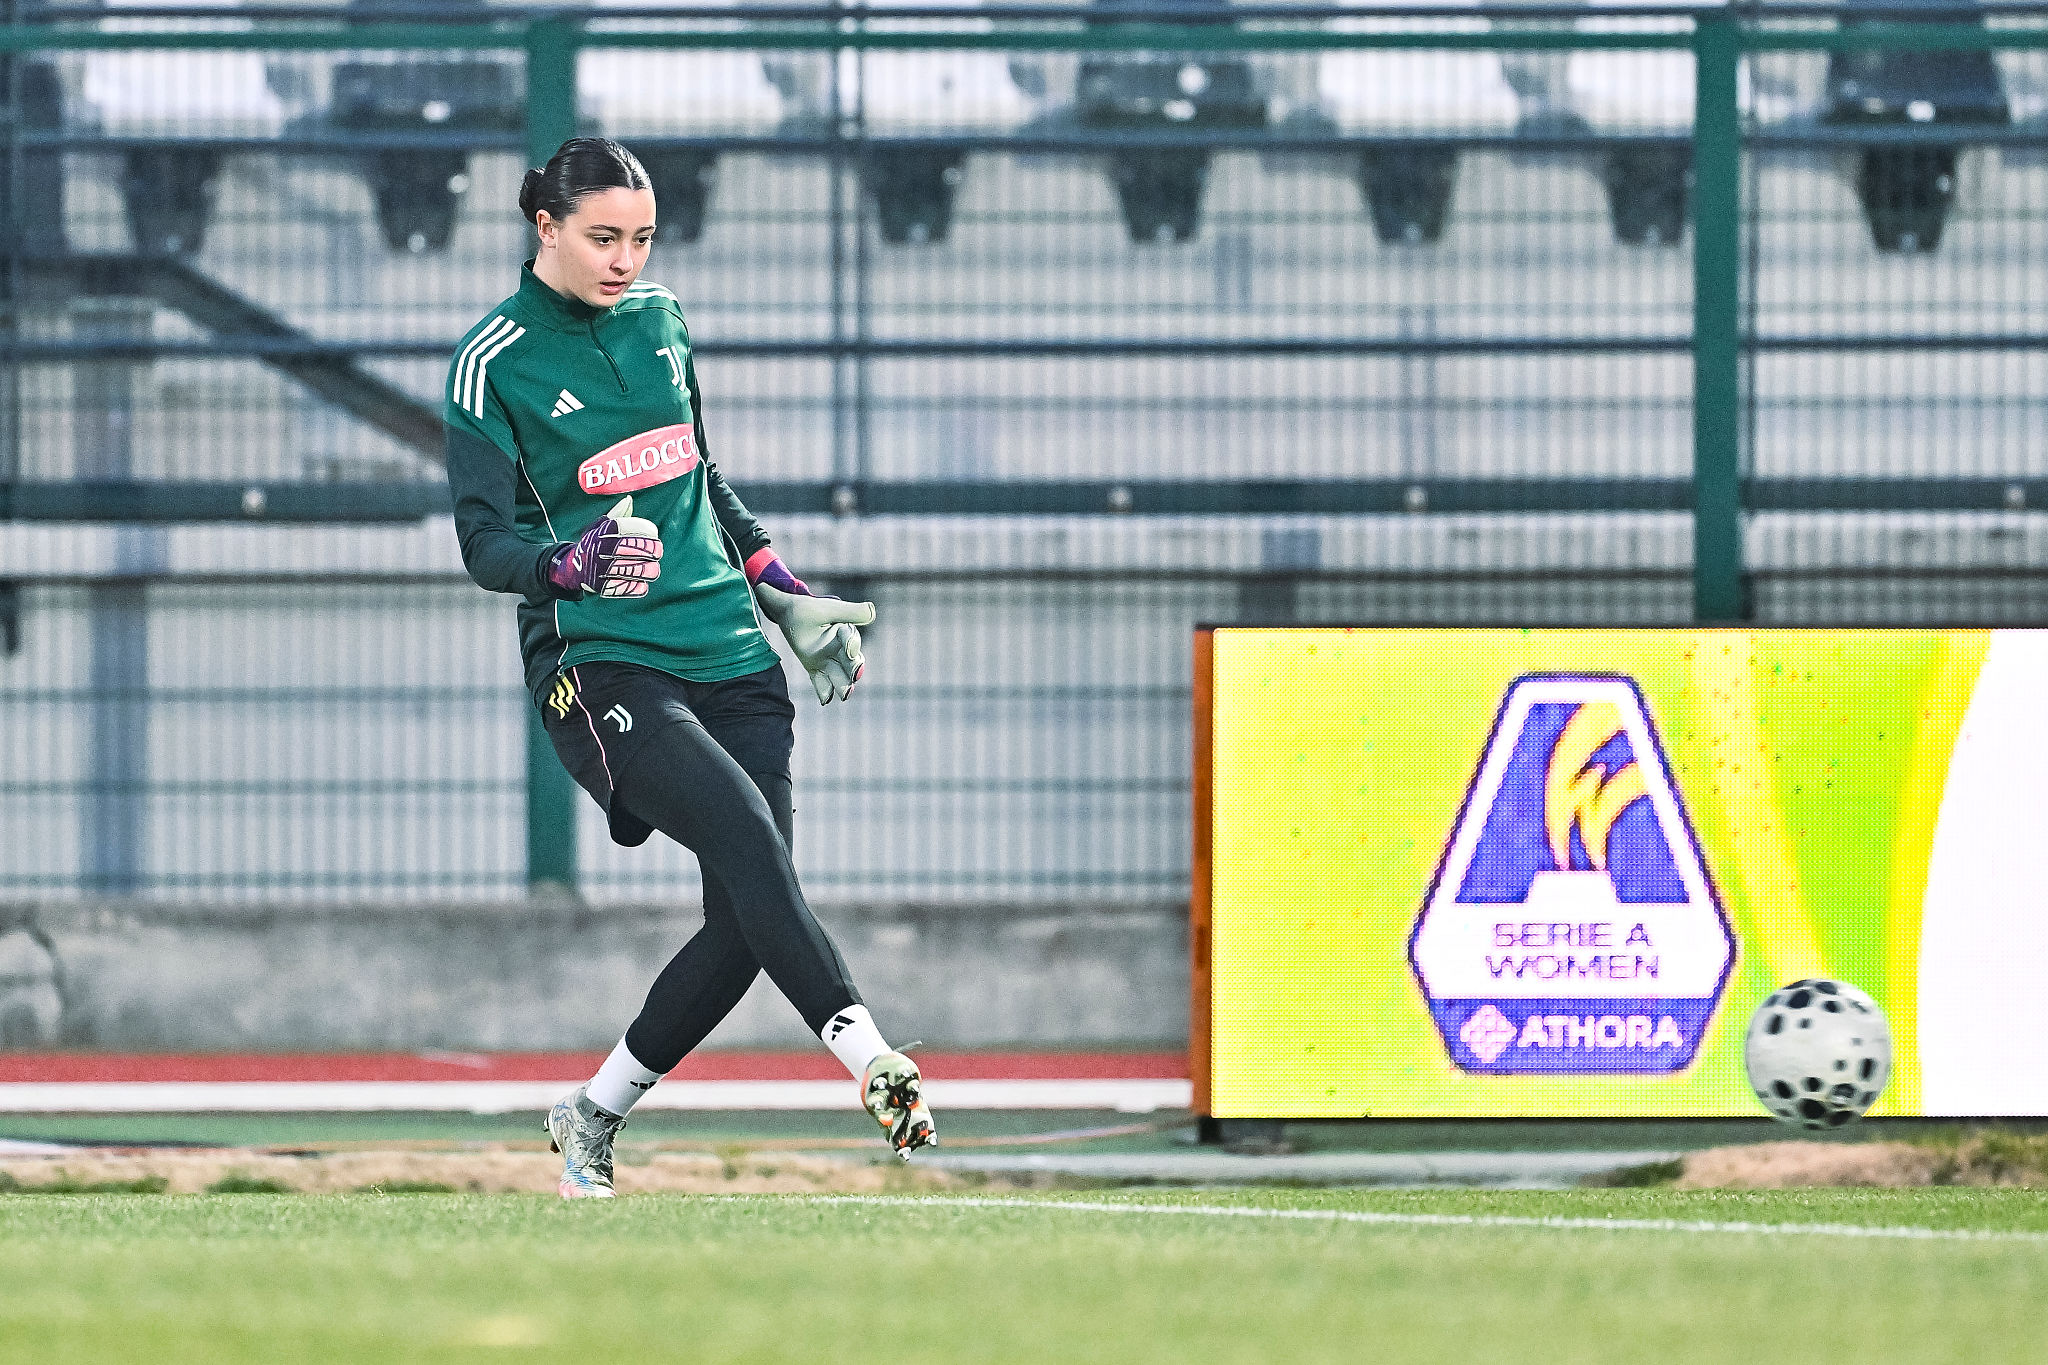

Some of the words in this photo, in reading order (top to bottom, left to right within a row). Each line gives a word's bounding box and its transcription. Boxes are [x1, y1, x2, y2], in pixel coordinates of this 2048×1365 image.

[1494, 922, 1614, 947] SERIE
[1625, 922, 1654, 947] A
[1485, 954, 1660, 979] WOMEN
[1516, 1014, 1684, 1049] ATHORA
